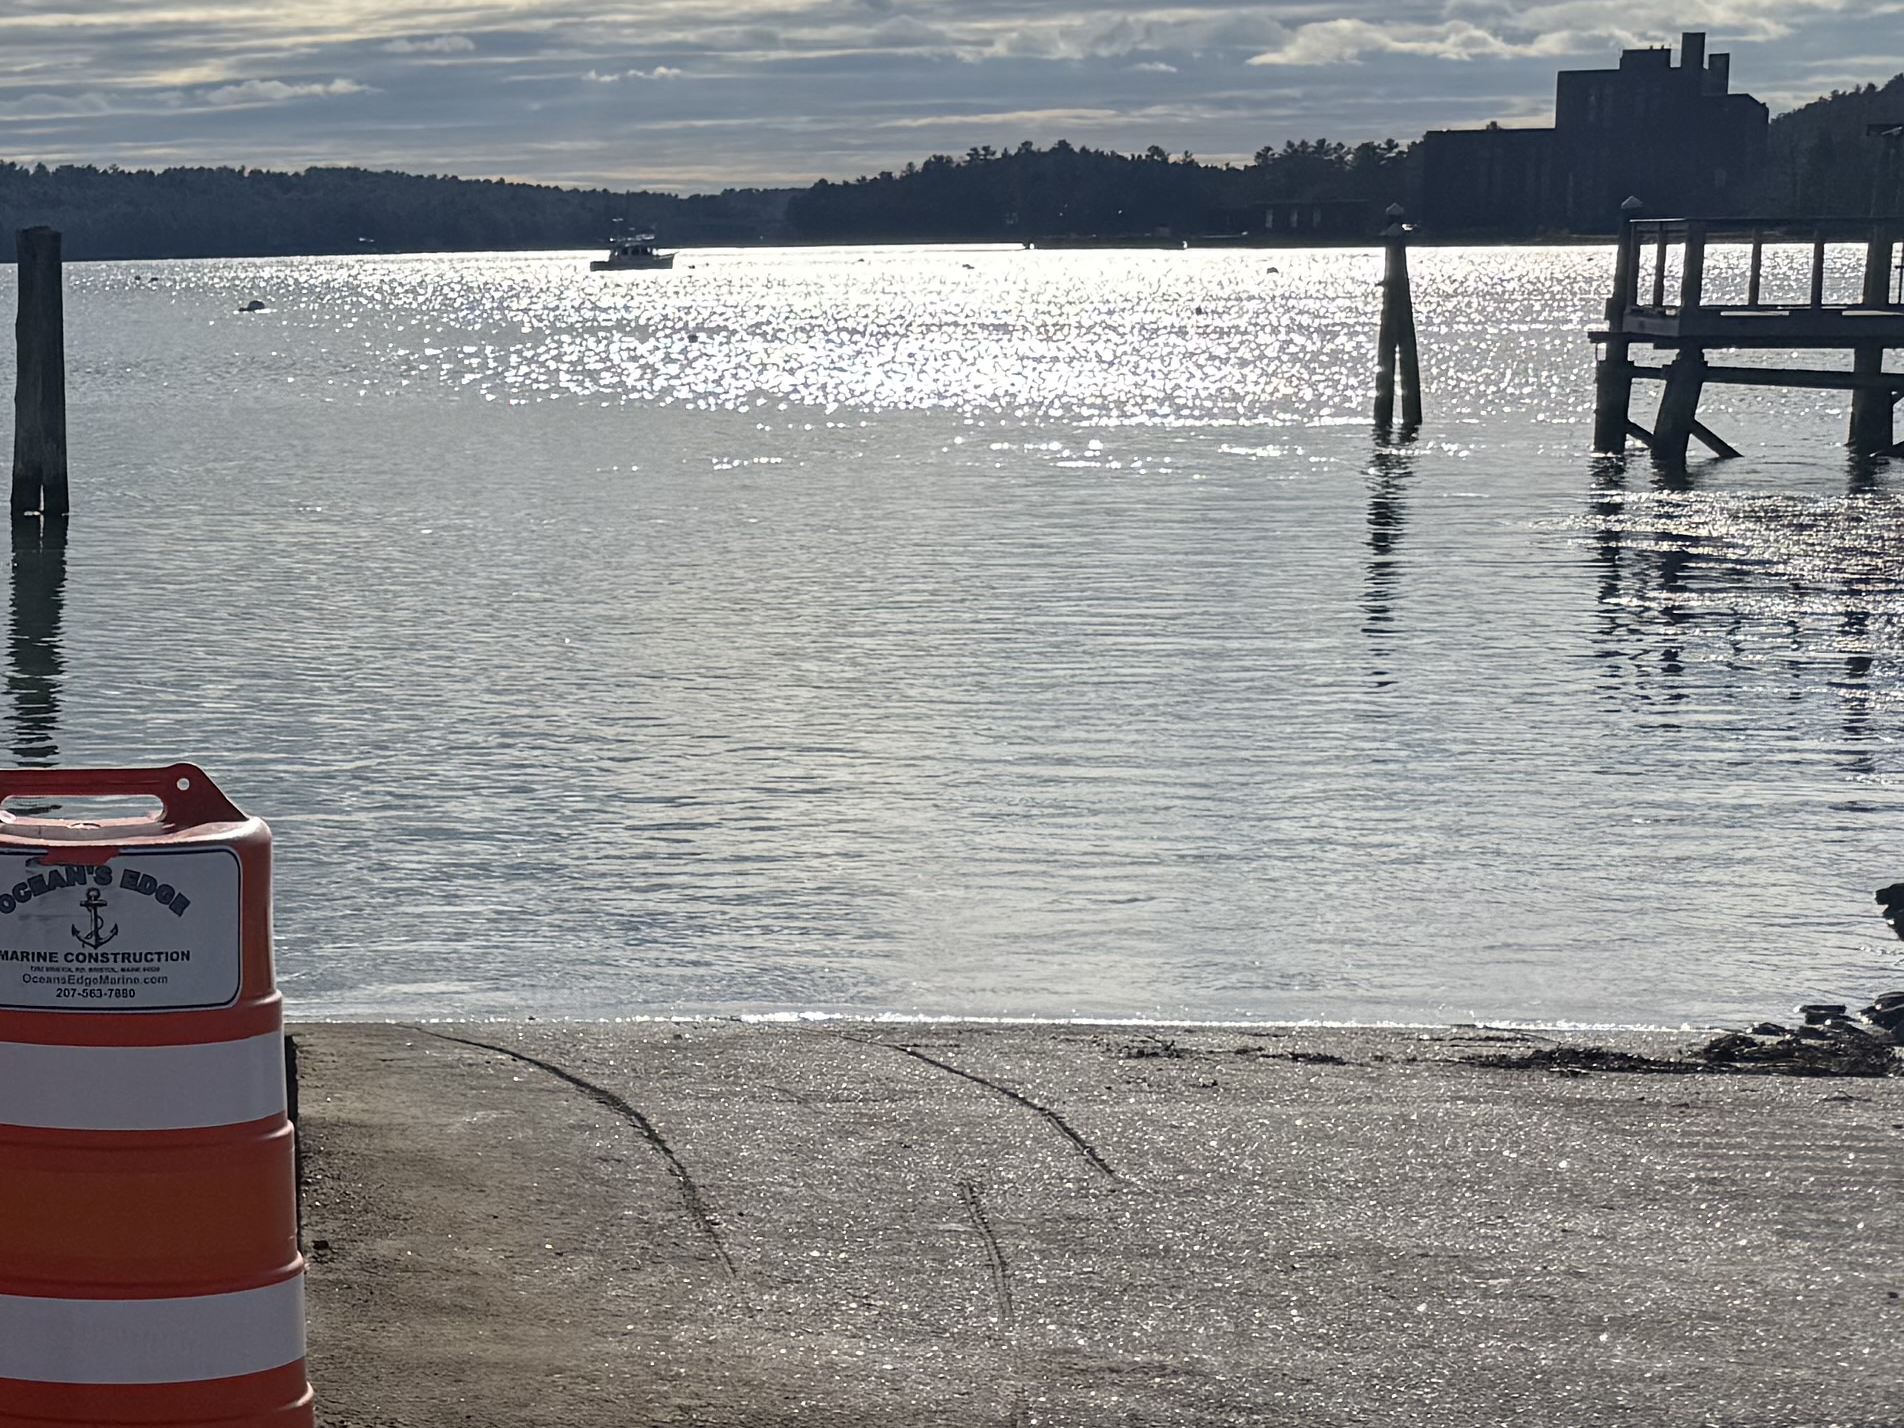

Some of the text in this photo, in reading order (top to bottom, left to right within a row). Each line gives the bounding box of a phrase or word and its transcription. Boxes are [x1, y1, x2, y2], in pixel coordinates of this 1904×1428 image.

[119, 868, 191, 918] EDGE
[63, 949, 191, 964] CONSTRUCTION
[21, 973, 169, 988] OceansEdgeMarine.com
[55, 987, 136, 999] 207-563-7880
